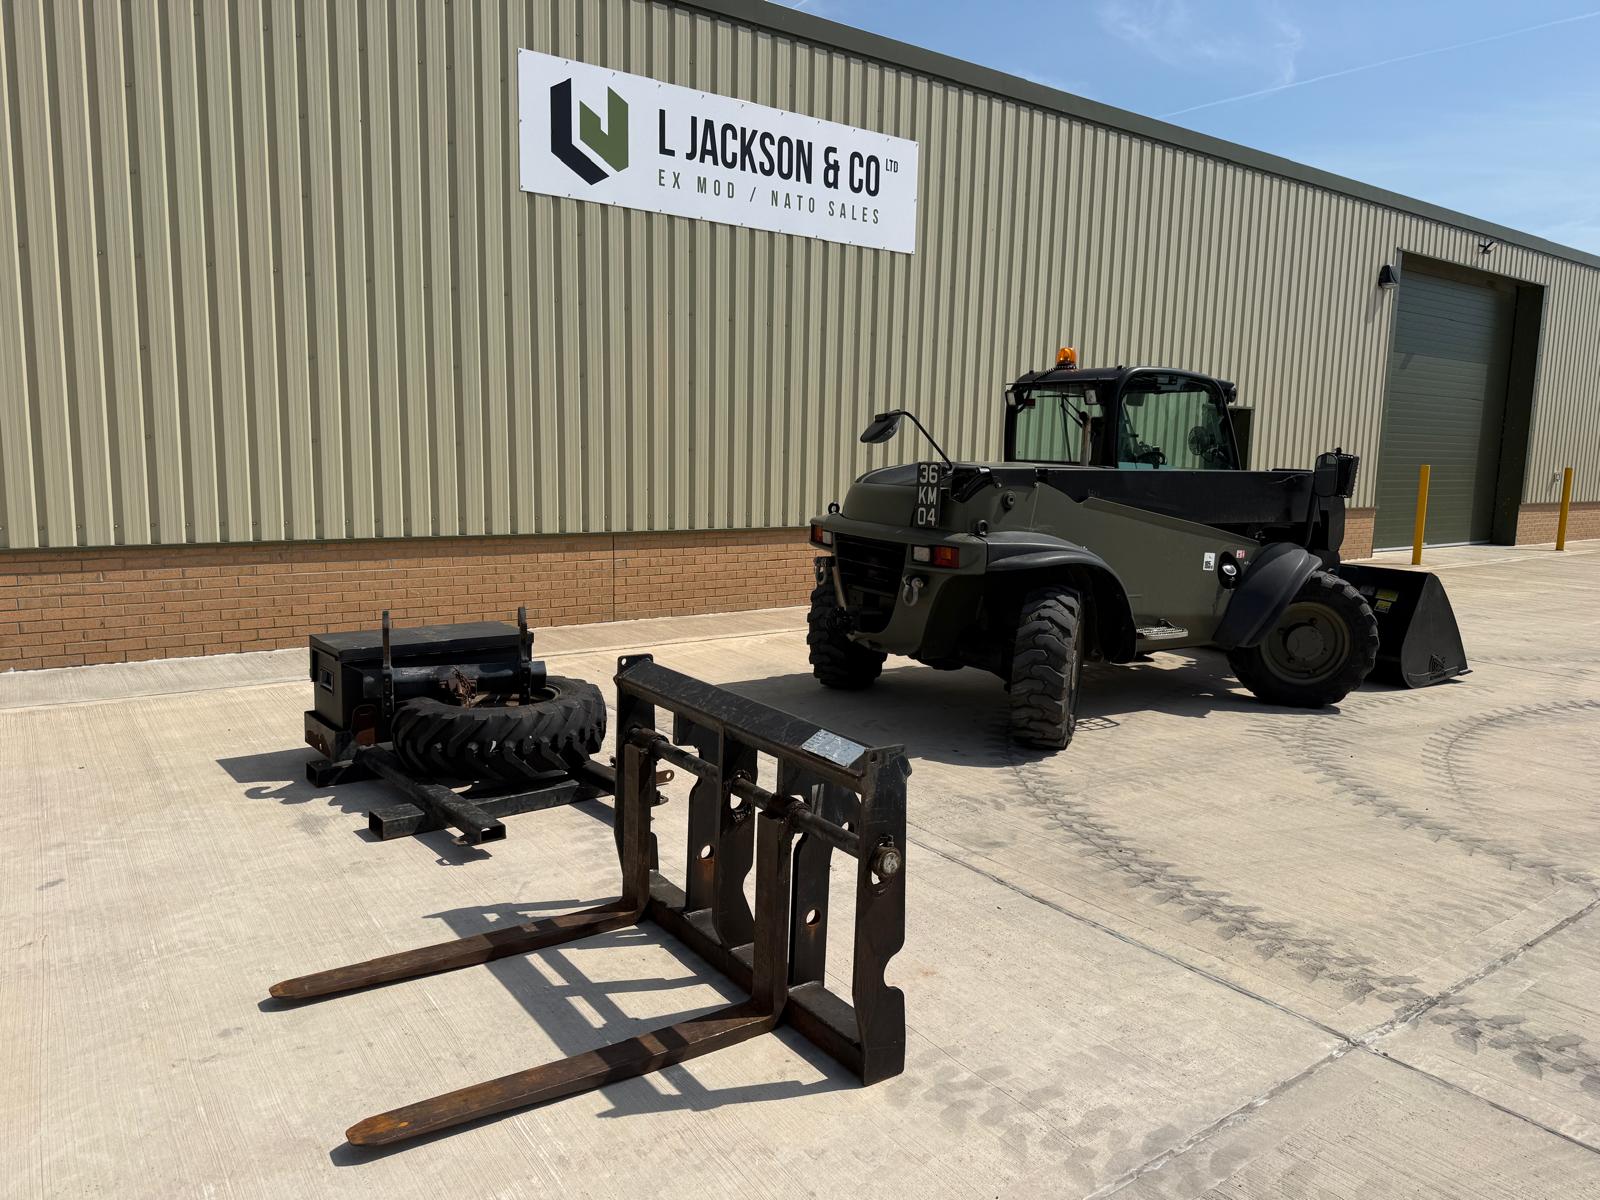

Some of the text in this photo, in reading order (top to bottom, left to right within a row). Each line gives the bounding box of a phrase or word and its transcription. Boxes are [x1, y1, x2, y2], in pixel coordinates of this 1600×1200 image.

[659, 109, 899, 197] L JACKSON & CO LTD
[658, 169, 681, 189] EX
[697, 176, 735, 199] MOD
[771, 190, 815, 213] NATO
[828, 201, 880, 224] SALES
[919, 464, 938, 484] 36
[918, 486, 937, 505] KM
[917, 507, 936, 527] 04
